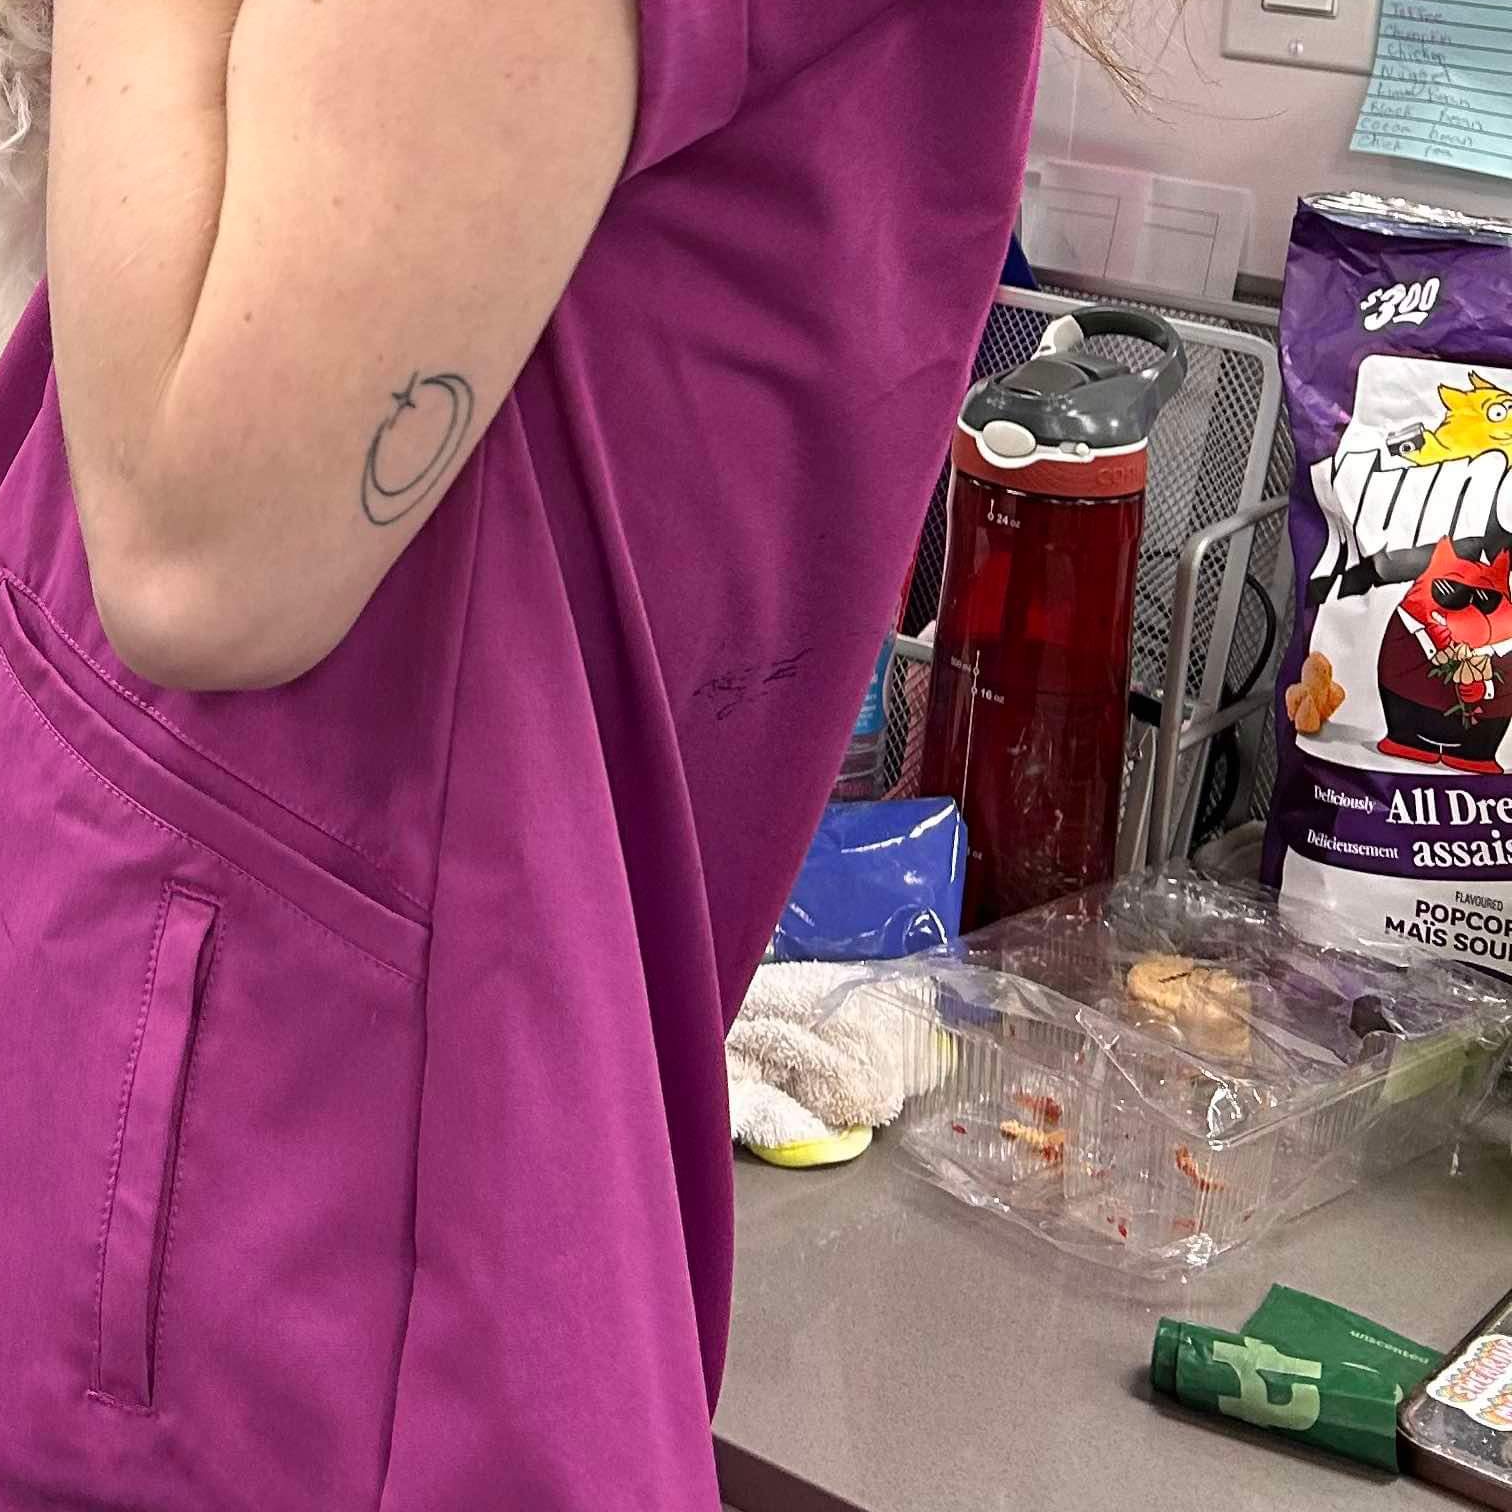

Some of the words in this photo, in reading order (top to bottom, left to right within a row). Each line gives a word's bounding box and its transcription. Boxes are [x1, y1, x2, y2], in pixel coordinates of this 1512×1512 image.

[996, 512, 1009, 526] 24
[1314, 784, 1377, 815] Deliciously
[1386, 787, 1441, 826] All
[1306, 828, 1399, 860] Délicieusement
[1454, 890, 1505, 913] FLAVOURED
[1384, 916, 1448, 949] MAÏS
[1453, 932, 1512, 961] SOU
[1348, 1329, 1430, 1365] unscented
